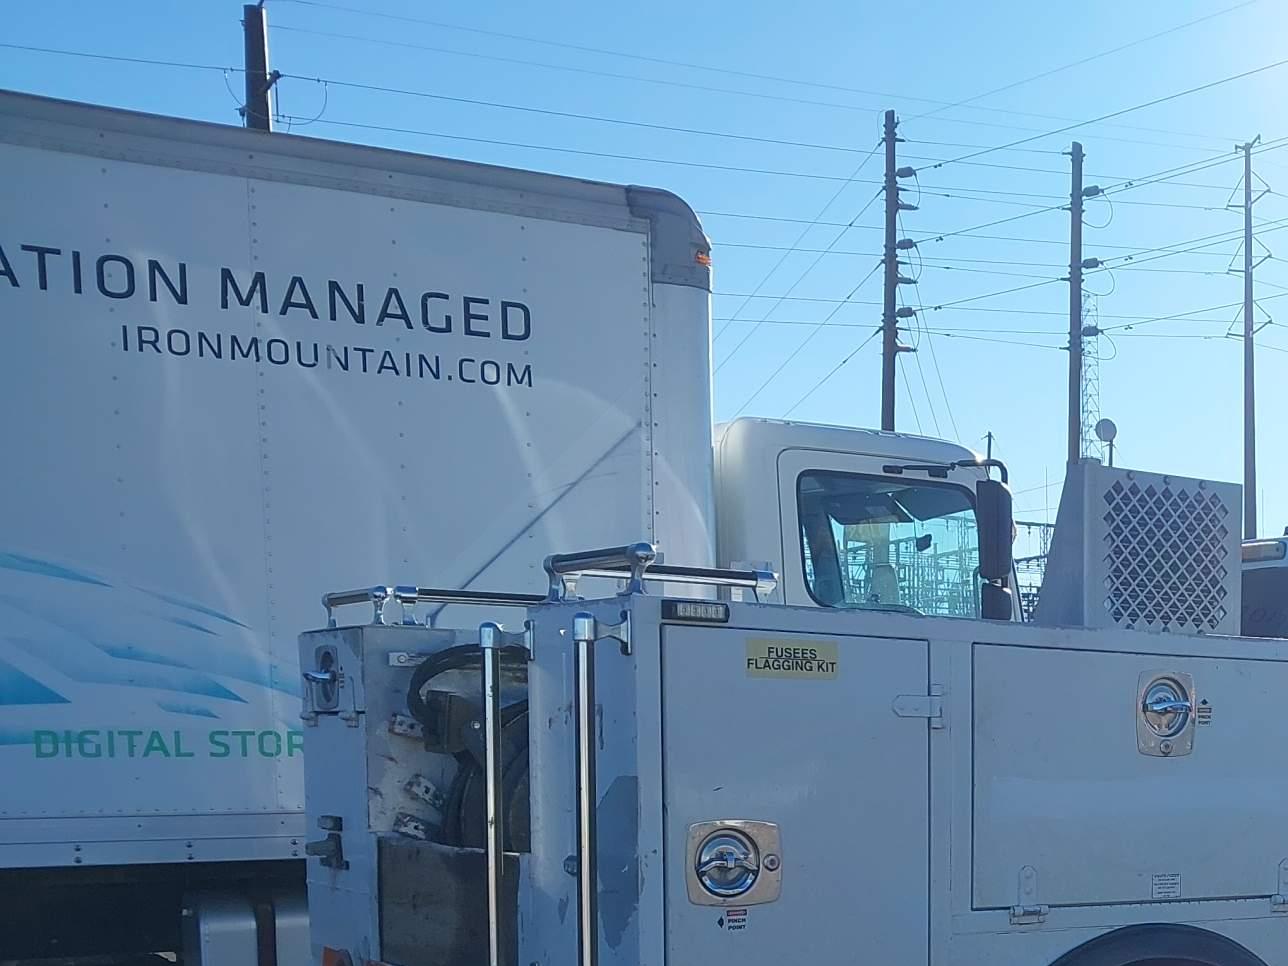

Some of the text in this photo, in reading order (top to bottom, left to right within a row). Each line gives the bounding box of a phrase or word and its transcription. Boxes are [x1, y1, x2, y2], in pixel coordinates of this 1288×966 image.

[220, 267, 531, 341] MANAGED
[121, 325, 533, 388] IRONMOUNTAIN.COM
[747, 658, 836, 673] FLAGGING KIT
[767, 646, 817, 659] FUSEES
[34, 730, 304, 758] DIGITAL STOR
